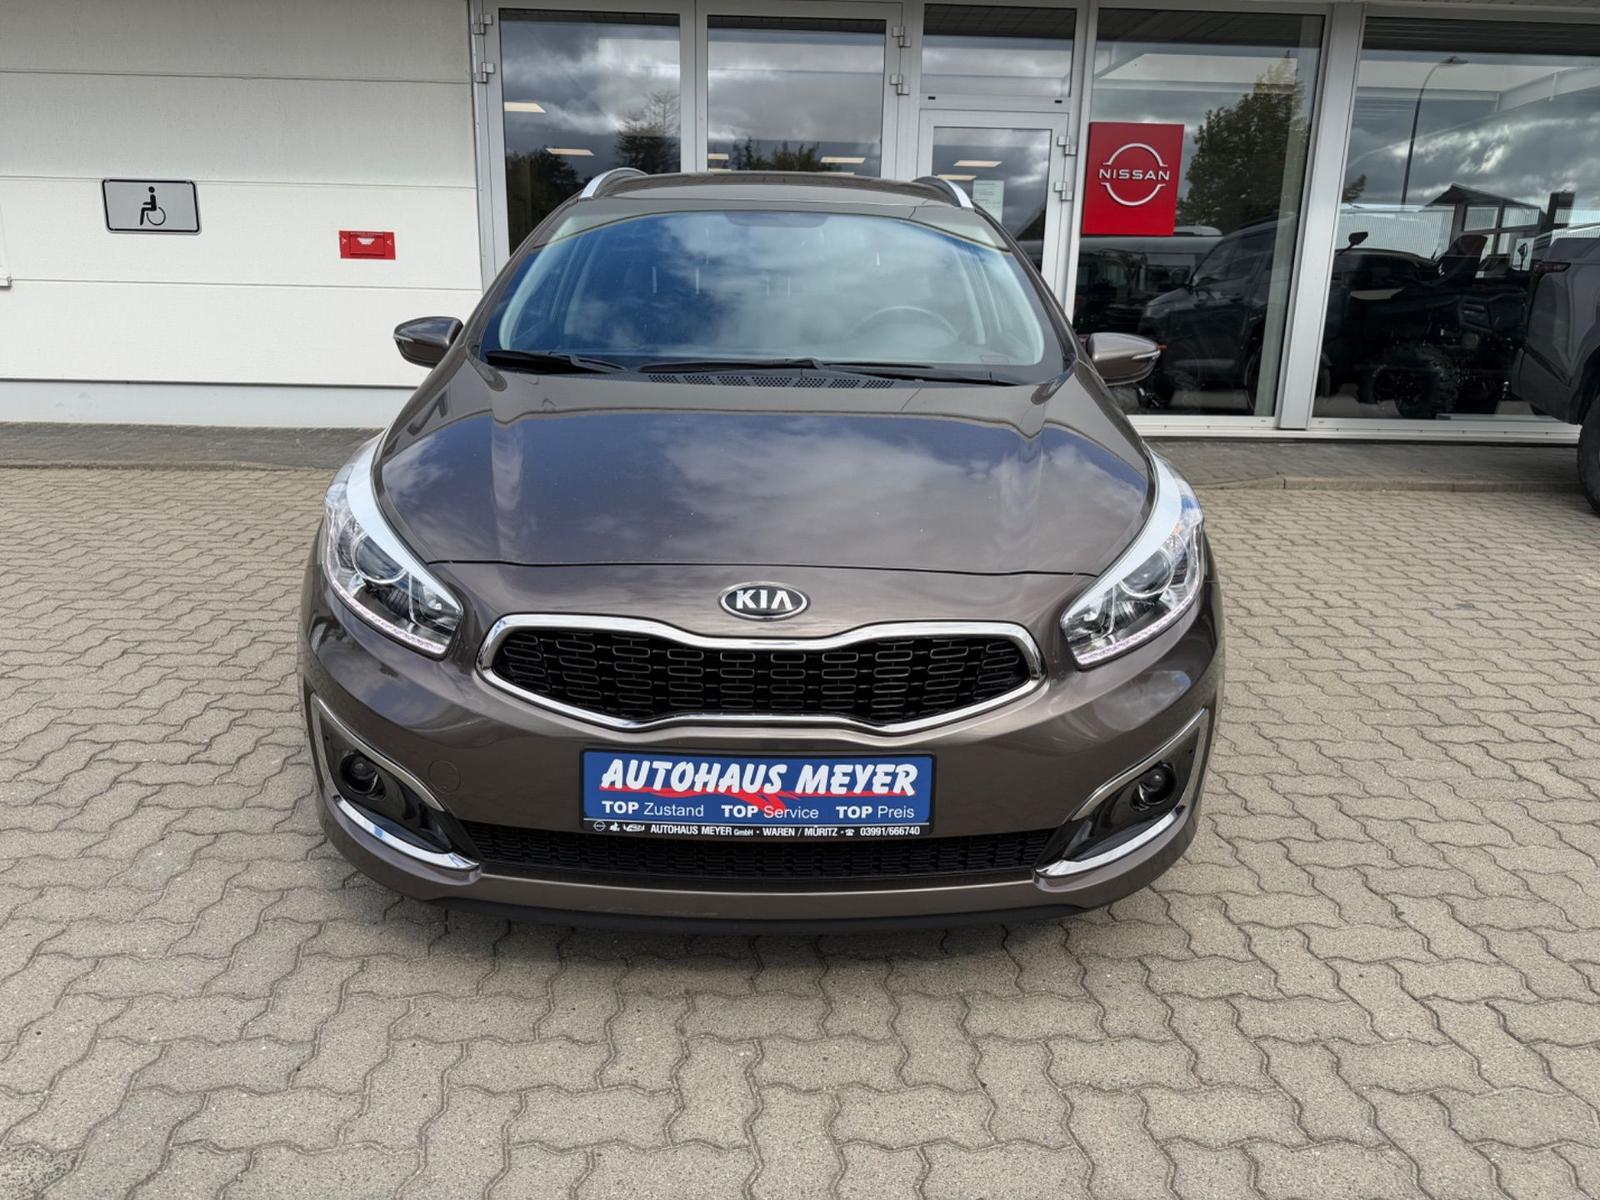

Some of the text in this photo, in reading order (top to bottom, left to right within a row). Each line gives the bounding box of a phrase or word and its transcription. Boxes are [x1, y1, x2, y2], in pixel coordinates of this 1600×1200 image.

[1099, 168, 1170, 180] NISSAN
[736, 589, 794, 610] KIA
[601, 758, 919, 796] AUTOHAUS MEYER
[602, 800, 915, 819] TOP Zustand TOP Service TOP Preis
[650, 824, 698, 835] AUTOHAUS
[701, 826, 732, 836] MEYER
[733, 828, 754, 837] GmbH
[763, 827, 795, 837] WAREN
[804, 825, 838, 837] MÜRITZ
[860, 826, 920, 837] 03991/666740
